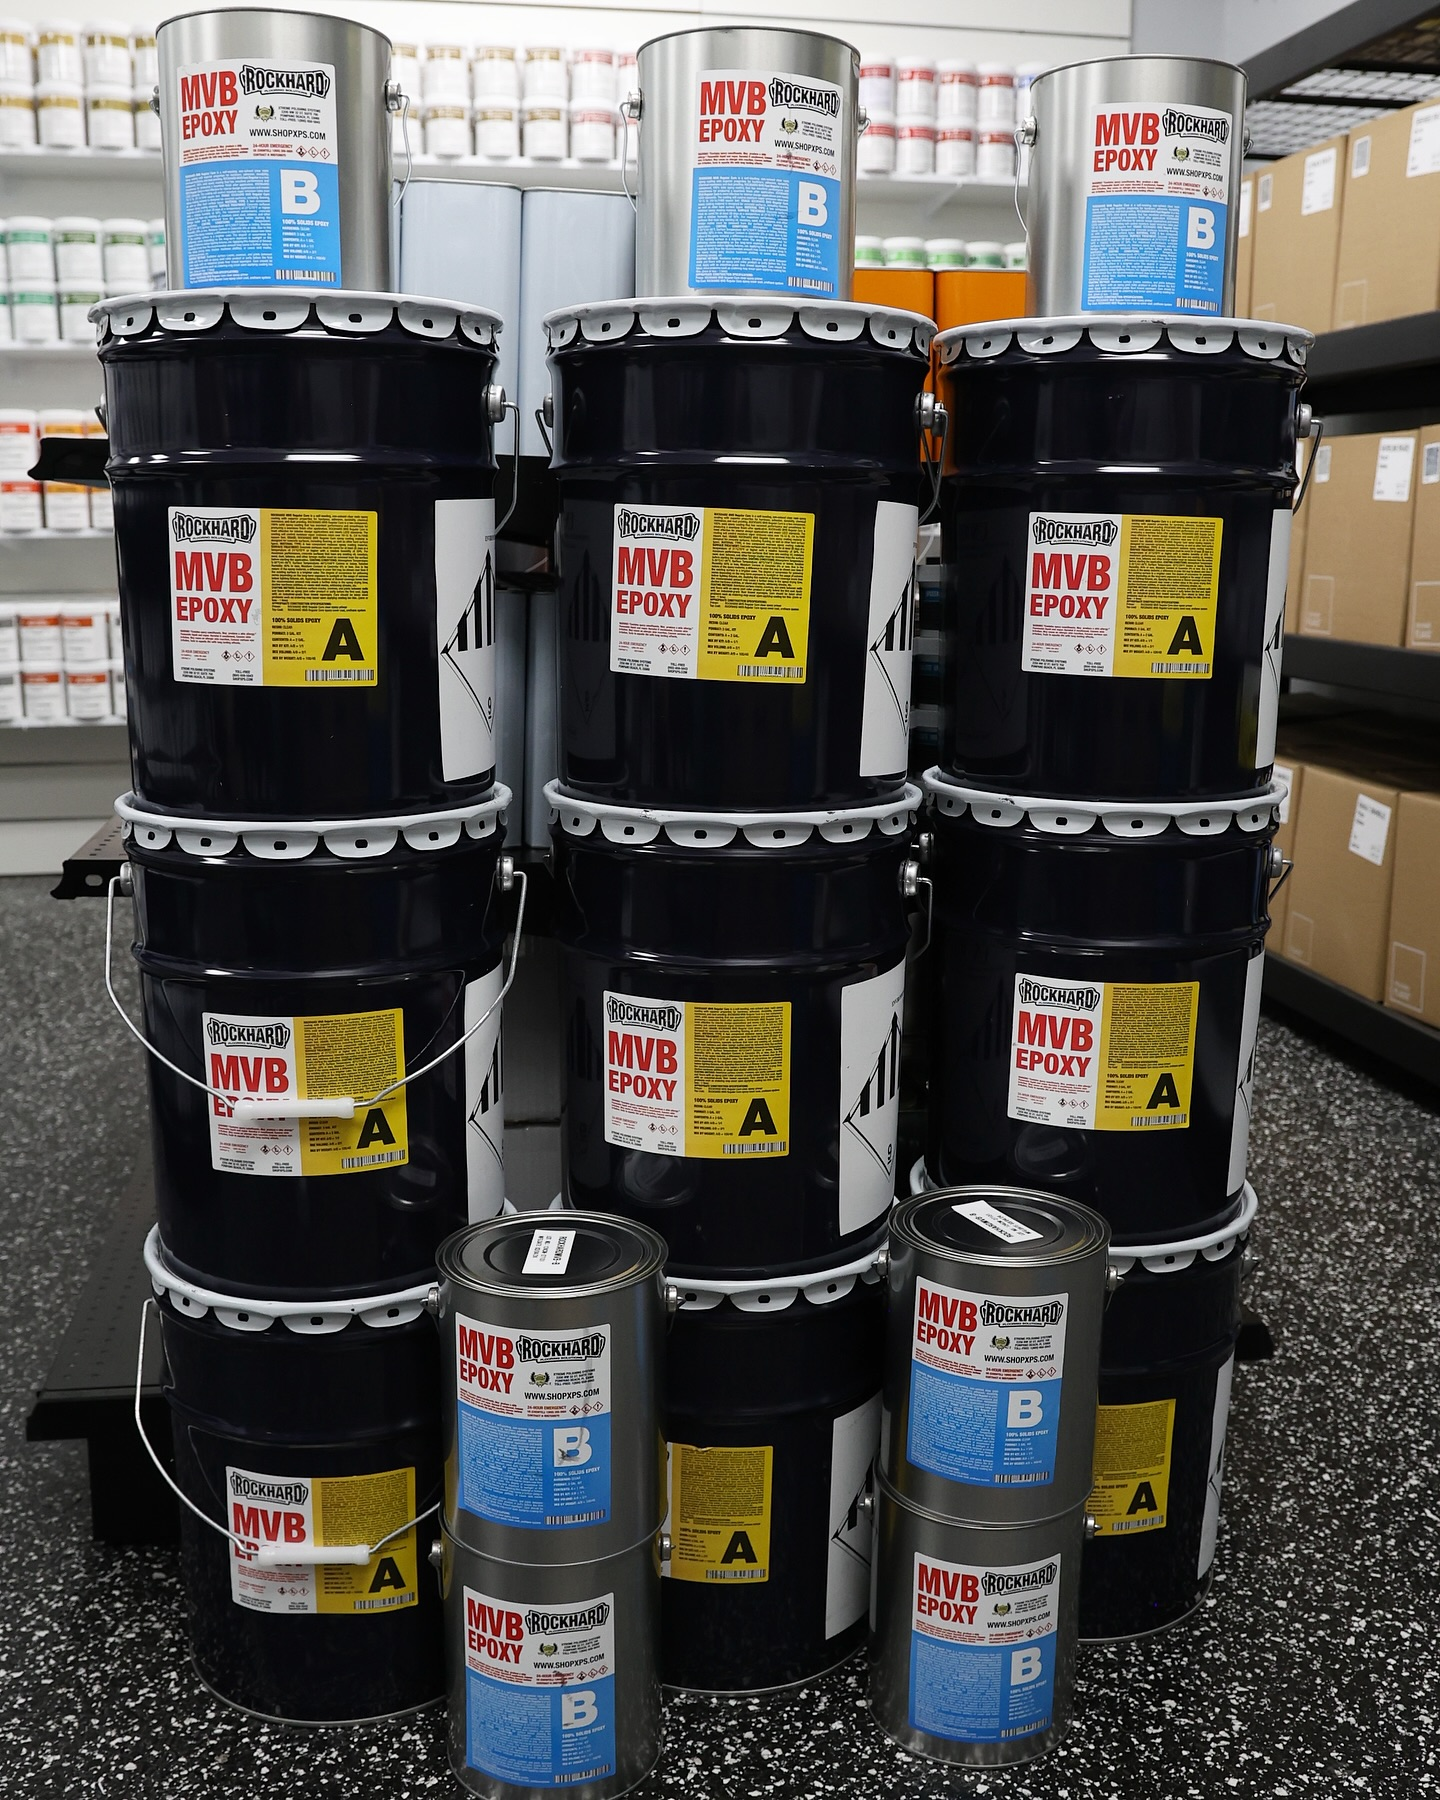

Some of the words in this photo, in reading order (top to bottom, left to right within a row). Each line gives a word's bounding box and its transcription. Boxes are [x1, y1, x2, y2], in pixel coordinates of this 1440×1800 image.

[181, 71, 238, 112] MVB
[245, 66, 327, 97] ROCKHARD
[700, 81, 767, 116] MVB
[774, 79, 838, 115] ROCKHARD
[182, 110, 238, 139] EPOXY
[249, 128, 326, 141] WWW.SHOPXPS.COM
[699, 118, 765, 143] EPOXY
[1095, 113, 1160, 147] MVB
[1169, 110, 1228, 143] ROCKHARD
[774, 139, 836, 157] WWW.SHOPXPS.COM
[1093, 148, 1158, 172] EPOXY
[1166, 167, 1224, 182] WWW.SHOPXPS.COM
[280, 169, 321, 215] B
[798, 181, 828, 227] B
[1187, 206, 1216, 250] B
[178, 514, 250, 542] ROCKHARD
[624, 511, 694, 539] ROCKHARD
[1038, 518, 1112, 546] ROCKHARD
[175, 551, 253, 593] MVB
[617, 546, 693, 589] MVB
[1031, 552, 1111, 592] MVB
[176, 596, 253, 624] EPOXY
[616, 590, 692, 619] EPOXY
[1030, 593, 1109, 620] EPOXY
[322, 618, 365, 661] A
[754, 616, 795, 659] A
[1167, 616, 1203, 655] A
[1024, 980, 1094, 1009] ROCKHARD
[611, 999, 675, 1030] ROCKHARD
[1017, 1011, 1093, 1051] MVB
[212, 1020, 285, 1048] ROCKHARD
[608, 1030, 678, 1075] MVB
[1016, 1048, 1091, 1077] EPOXY
[210, 1053, 289, 1093] MVB
[608, 1069, 677, 1101] EPOXY
[1146, 1073, 1180, 1109] A
[356, 1107, 396, 1149] A
[738, 1098, 777, 1136] A
[918, 1287, 978, 1332] MVB
[985, 1302, 1059, 1325] ROCKHARD
[459, 1324, 515, 1369] MVB
[522, 1334, 600, 1360] ROCKHARD
[917, 1323, 976, 1356] EPOXY
[984, 1354, 1055, 1364] WWW.SHOPXPS.COM
[459, 1359, 514, 1394] EPOXY
[524, 1388, 600, 1400] WWW.SHOPXPS.COM
[1007, 1390, 1043, 1429] B
[554, 1426, 592, 1467] B
[235, 1473, 302, 1504] ROCKHARD
[1126, 1481, 1158, 1515] A
[233, 1502, 306, 1543] MVB
[720, 1531, 758, 1564] A
[368, 1556, 406, 1594] A
[918, 1563, 980, 1603] MVB
[987, 1564, 1053, 1595] ROCKHARD
[467, 1597, 524, 1642] MVB
[530, 1604, 604, 1633] ROCKHARD
[917, 1593, 978, 1625] EPOXY
[987, 1611, 1051, 1629] WWW.SHOPXPS.COM
[468, 1628, 523, 1664] EPOXY
[533, 1653, 605, 1669] WWW.SHOPXPS.COM
[1010, 1647, 1042, 1687] B
[561, 1690, 598, 1730] B
